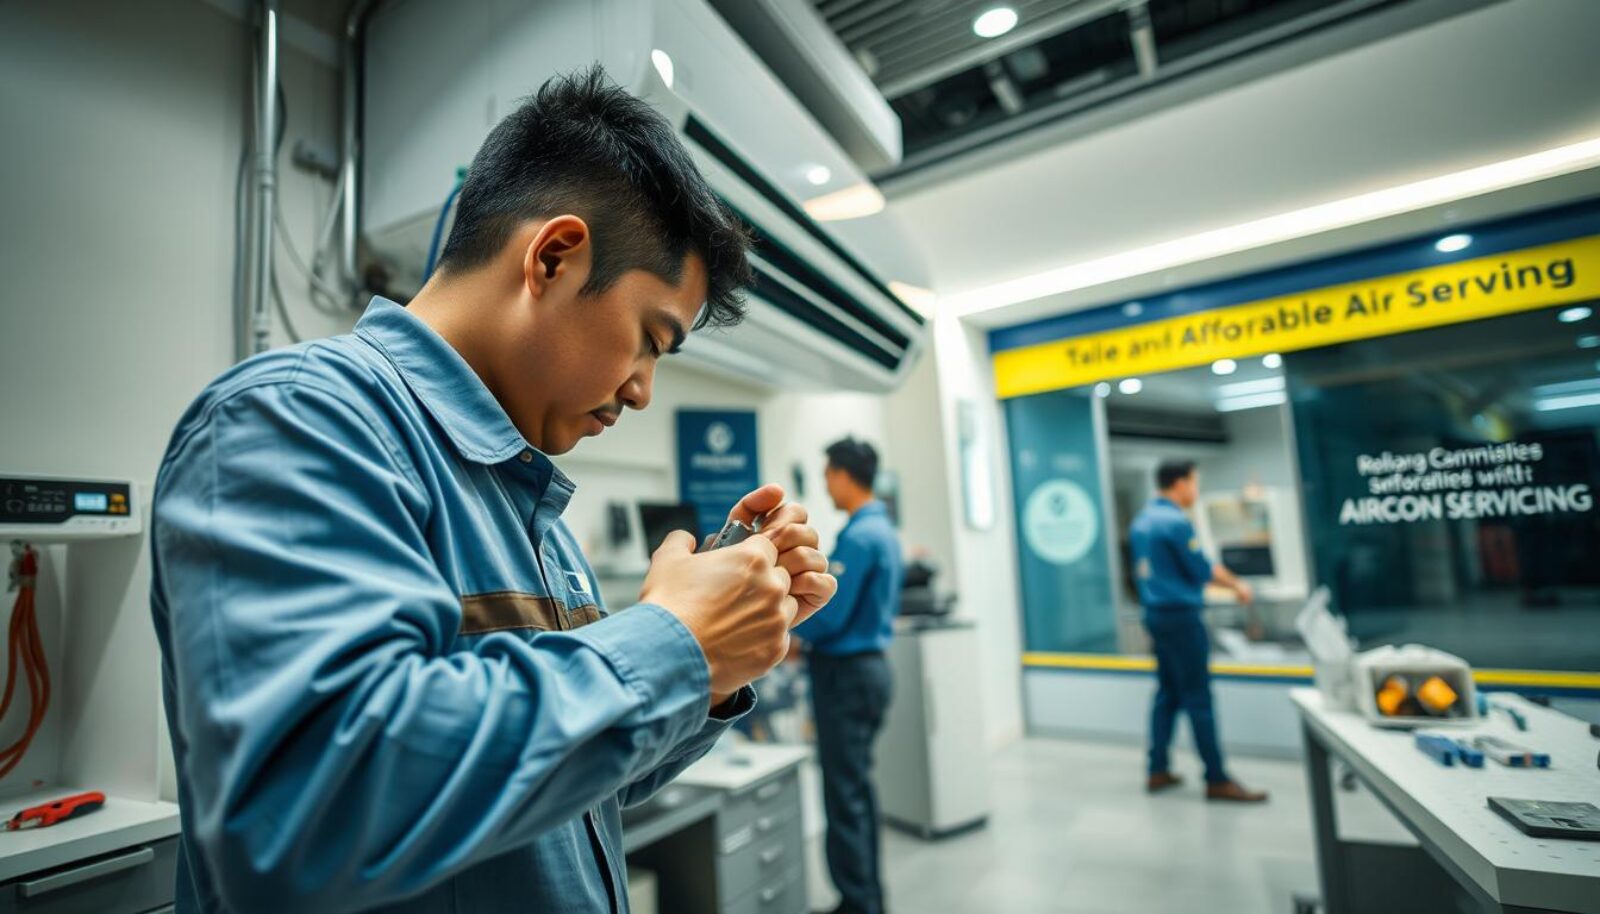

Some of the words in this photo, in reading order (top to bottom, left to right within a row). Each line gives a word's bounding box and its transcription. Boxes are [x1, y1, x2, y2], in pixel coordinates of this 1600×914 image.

[1181, 302, 1332, 347] Afforable
[1346, 291, 1394, 319] Air
[1406, 258, 1576, 308] Serving
[1339, 495, 1443, 525] AIRCON
[1447, 484, 1592, 519] SERVICING
